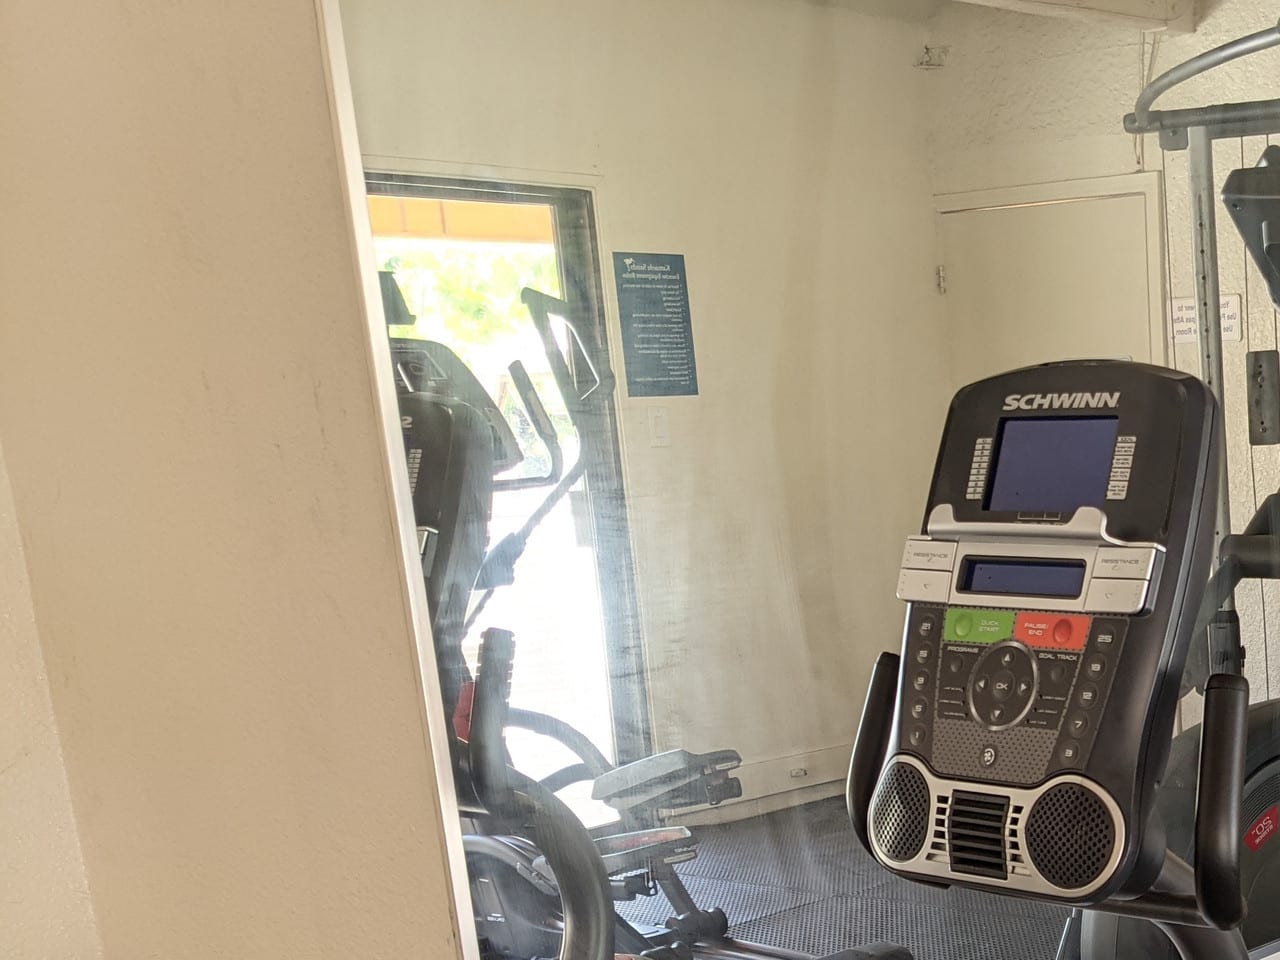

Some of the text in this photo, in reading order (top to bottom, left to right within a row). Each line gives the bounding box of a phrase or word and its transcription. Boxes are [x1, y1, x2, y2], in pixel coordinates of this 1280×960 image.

[1002, 391, 1120, 411] SCHWINN
[1097, 634, 1112, 643] 25
[1057, 654, 1078, 662] TRACK
[1074, 720, 1082, 728] 7
